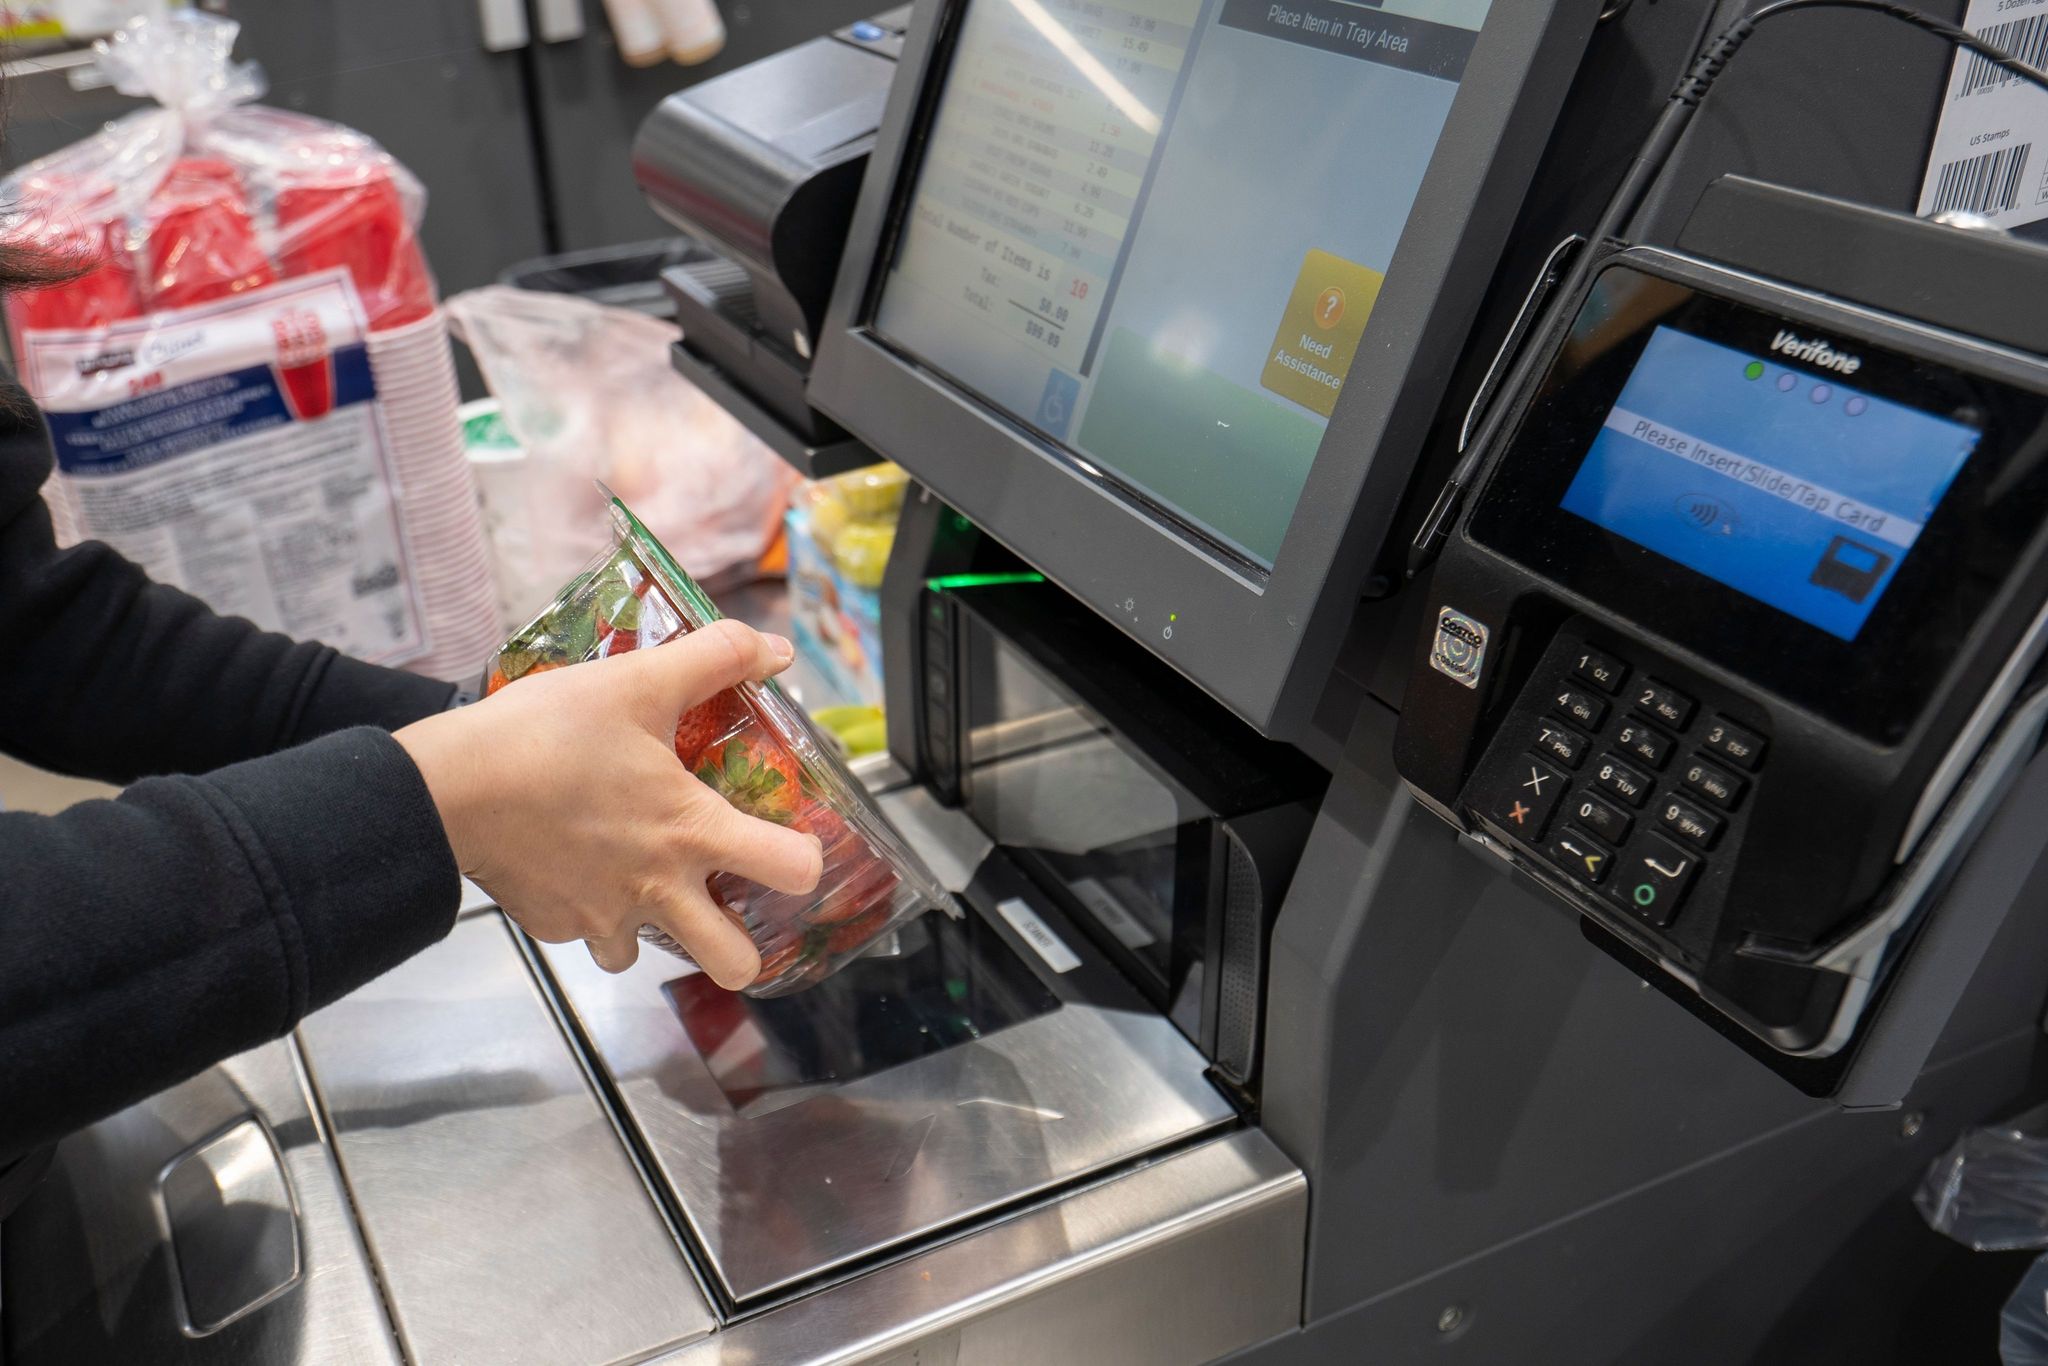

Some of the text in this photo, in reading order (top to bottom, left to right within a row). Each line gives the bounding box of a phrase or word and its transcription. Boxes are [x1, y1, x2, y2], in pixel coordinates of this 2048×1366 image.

[1266, 4, 1409, 53] Place Item in Tray Area
[1970, 129, 2010, 146] US Stamps
[1001, 246, 1032, 273] Items
[1037, 263, 1051, 281] is
[1070, 278, 1089, 301] 10
[1299, 334, 1333, 359] Need
[1770, 329, 1862, 375] Verifone
[1274, 349, 1341, 389] Assistance
[1632, 419, 1888, 534] Please Insert/Slide/Tap Card
[1441, 616, 1482, 645] COSTCO
[1579, 655, 1589, 669] 1
[1558, 692, 1591, 720] 4 GHI
[1640, 690, 1679, 719] 2 ABC
[1540, 728, 1572, 758] 7 PRS
[1620, 728, 1656, 759] 5 JKL
[1709, 727, 1749, 757] 3 DEF
[1600, 765, 1637, 796] 8 TUV
[1688, 767, 1728, 799] 6 MNO
[1580, 803, 1592, 817] 0
[1665, 805, 1706, 838] 9 WXY
